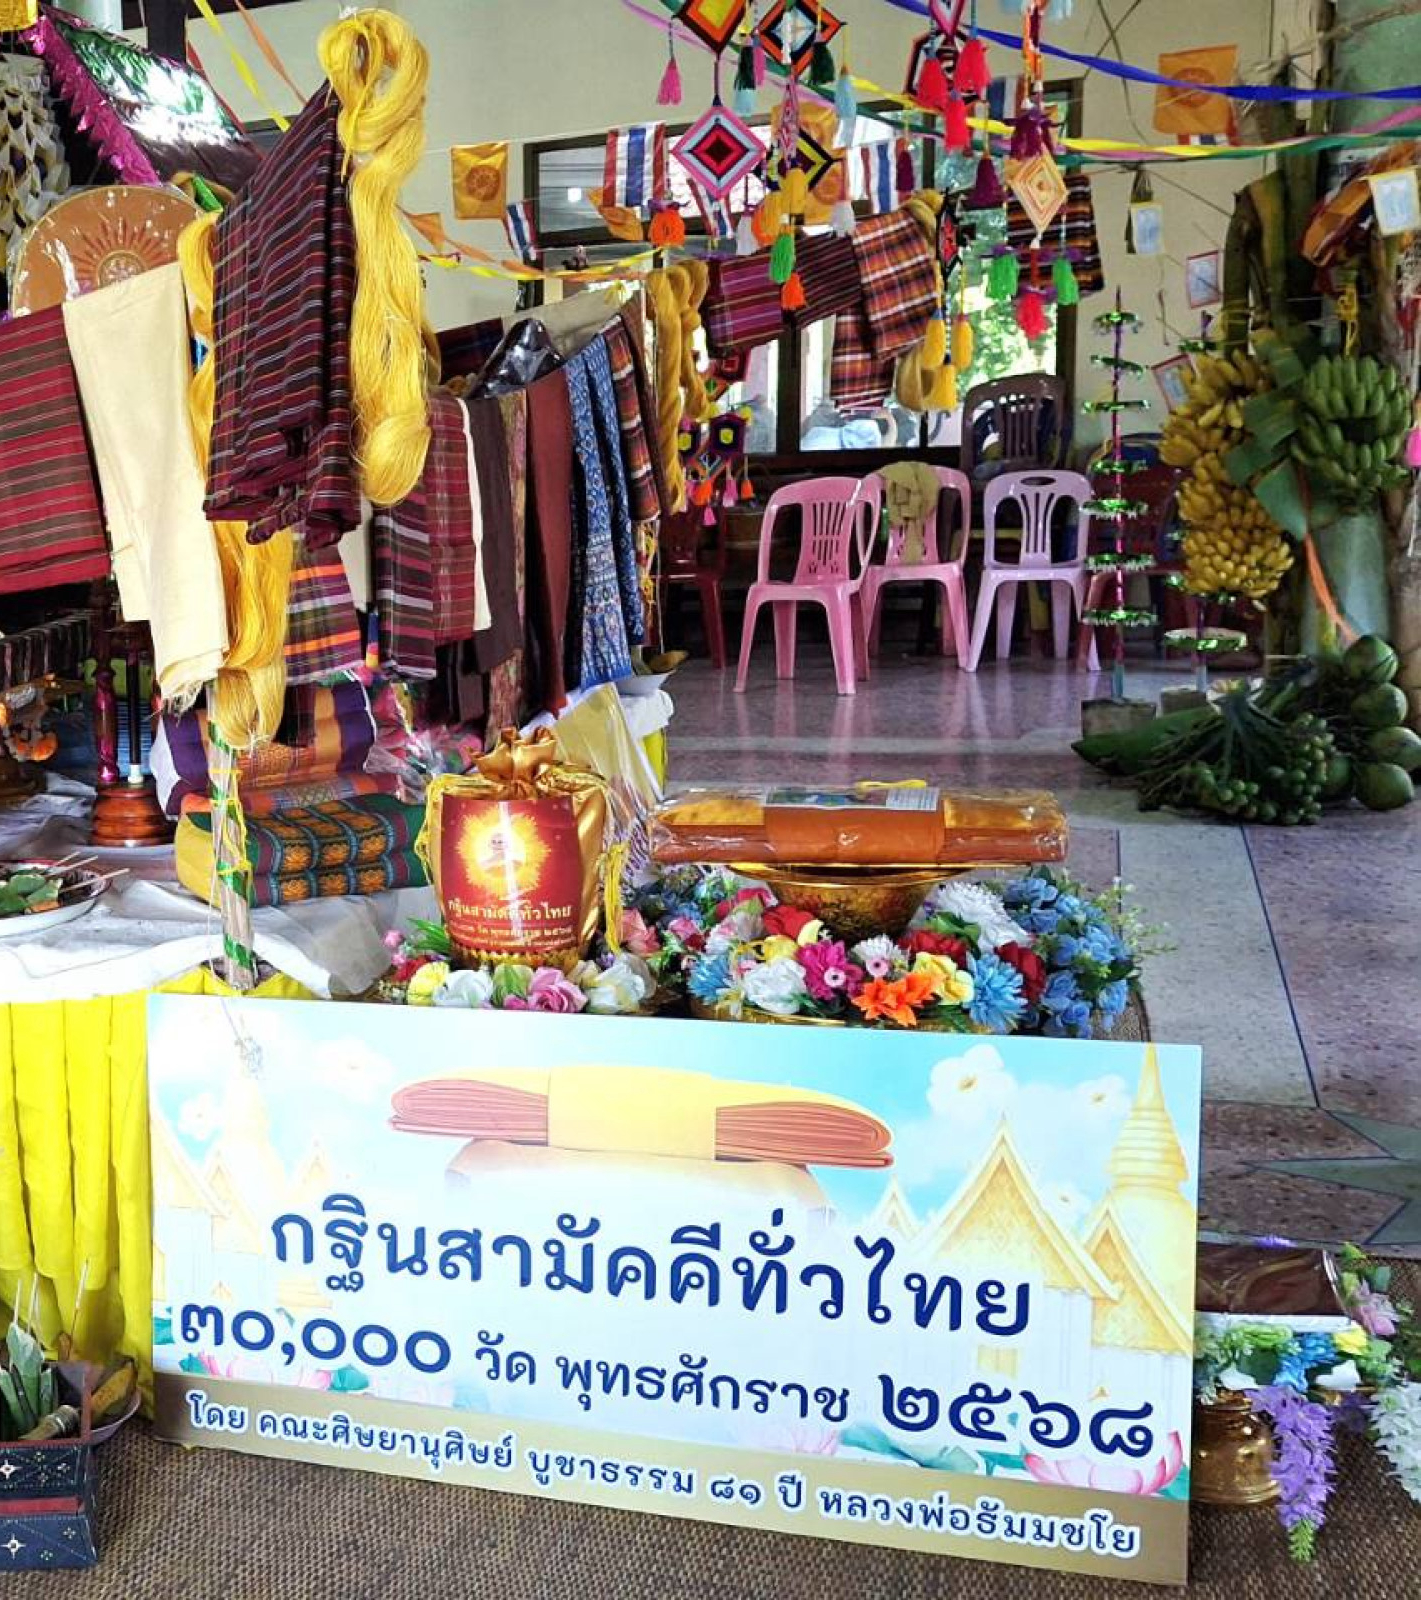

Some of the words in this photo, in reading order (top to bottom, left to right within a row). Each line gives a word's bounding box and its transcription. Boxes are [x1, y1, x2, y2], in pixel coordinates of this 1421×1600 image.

[271, 1193, 1030, 1336] กฐินสามัคคีทั่วไทย
[181, 1303, 452, 1373] ๓๐,๐๐๐
[475, 1330, 537, 1386] วัด
[556, 1353, 850, 1423] พุทธศักราช
[878, 1374, 1154, 1458] ๒๕๖๘
[189, 1394, 245, 1430] โดย
[260, 1413, 513, 1468] คณะศิษยานุศิษย์
[529, 1451, 694, 1494] บูชาธรรม
[710, 1476, 762, 1505] ๘๑
[778, 1475, 803, 1509] ปี
[820, 1489, 1135, 1553] หลวงพ่อธัมมชโย
